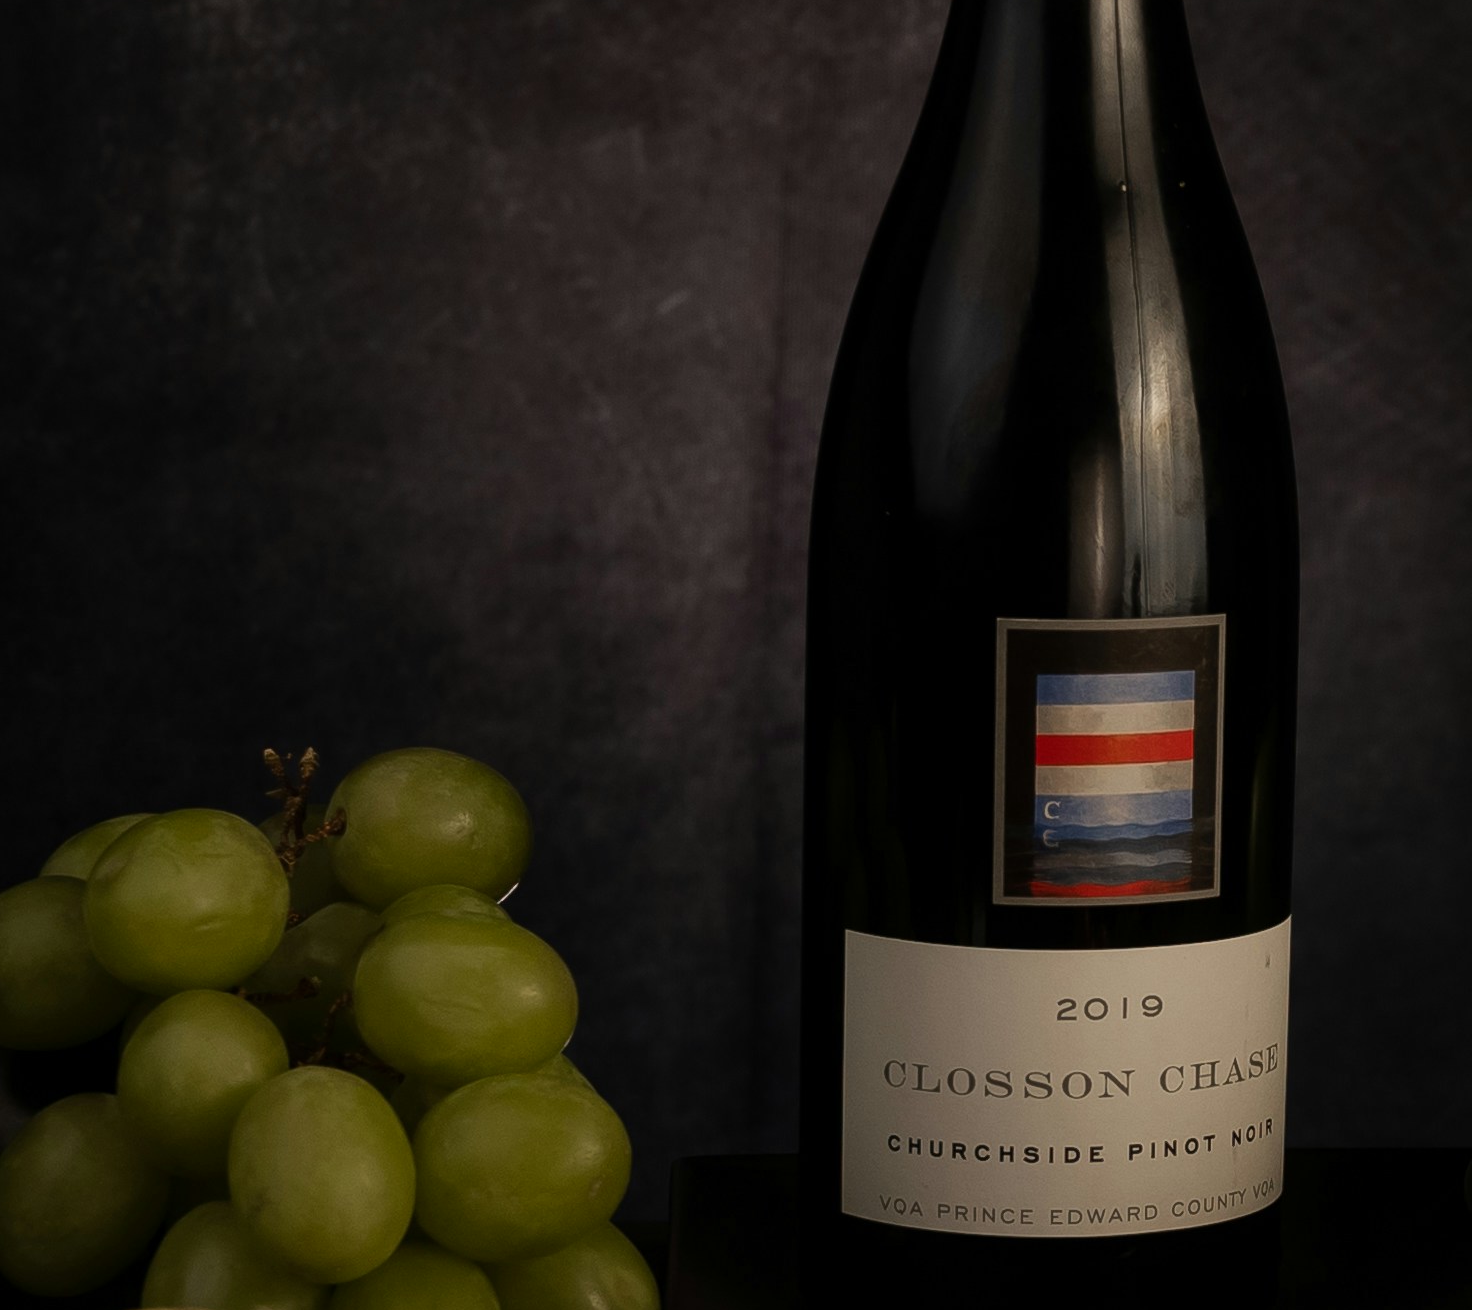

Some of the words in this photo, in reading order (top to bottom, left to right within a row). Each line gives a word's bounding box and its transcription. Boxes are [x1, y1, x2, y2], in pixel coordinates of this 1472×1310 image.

[1044, 800, 1061, 819] C
[1056, 994, 1164, 1021] 2019
[883, 1059, 1136, 1100] CLOSSON
[1159, 1042, 1279, 1094] CHASE
[887, 1134, 1105, 1164] CHURCHSIDE
[1128, 1134, 1216, 1161] PINOT
[1231, 1118, 1274, 1149] NOIR
[879, 1194, 923, 1216] VQA
[937, 1203, 1034, 1225] PRINCE
[1050, 1204, 1159, 1225] EDWARD
[1171, 1188, 1247, 1218] COUNTY
[1252, 1177, 1275, 1200] VQA
